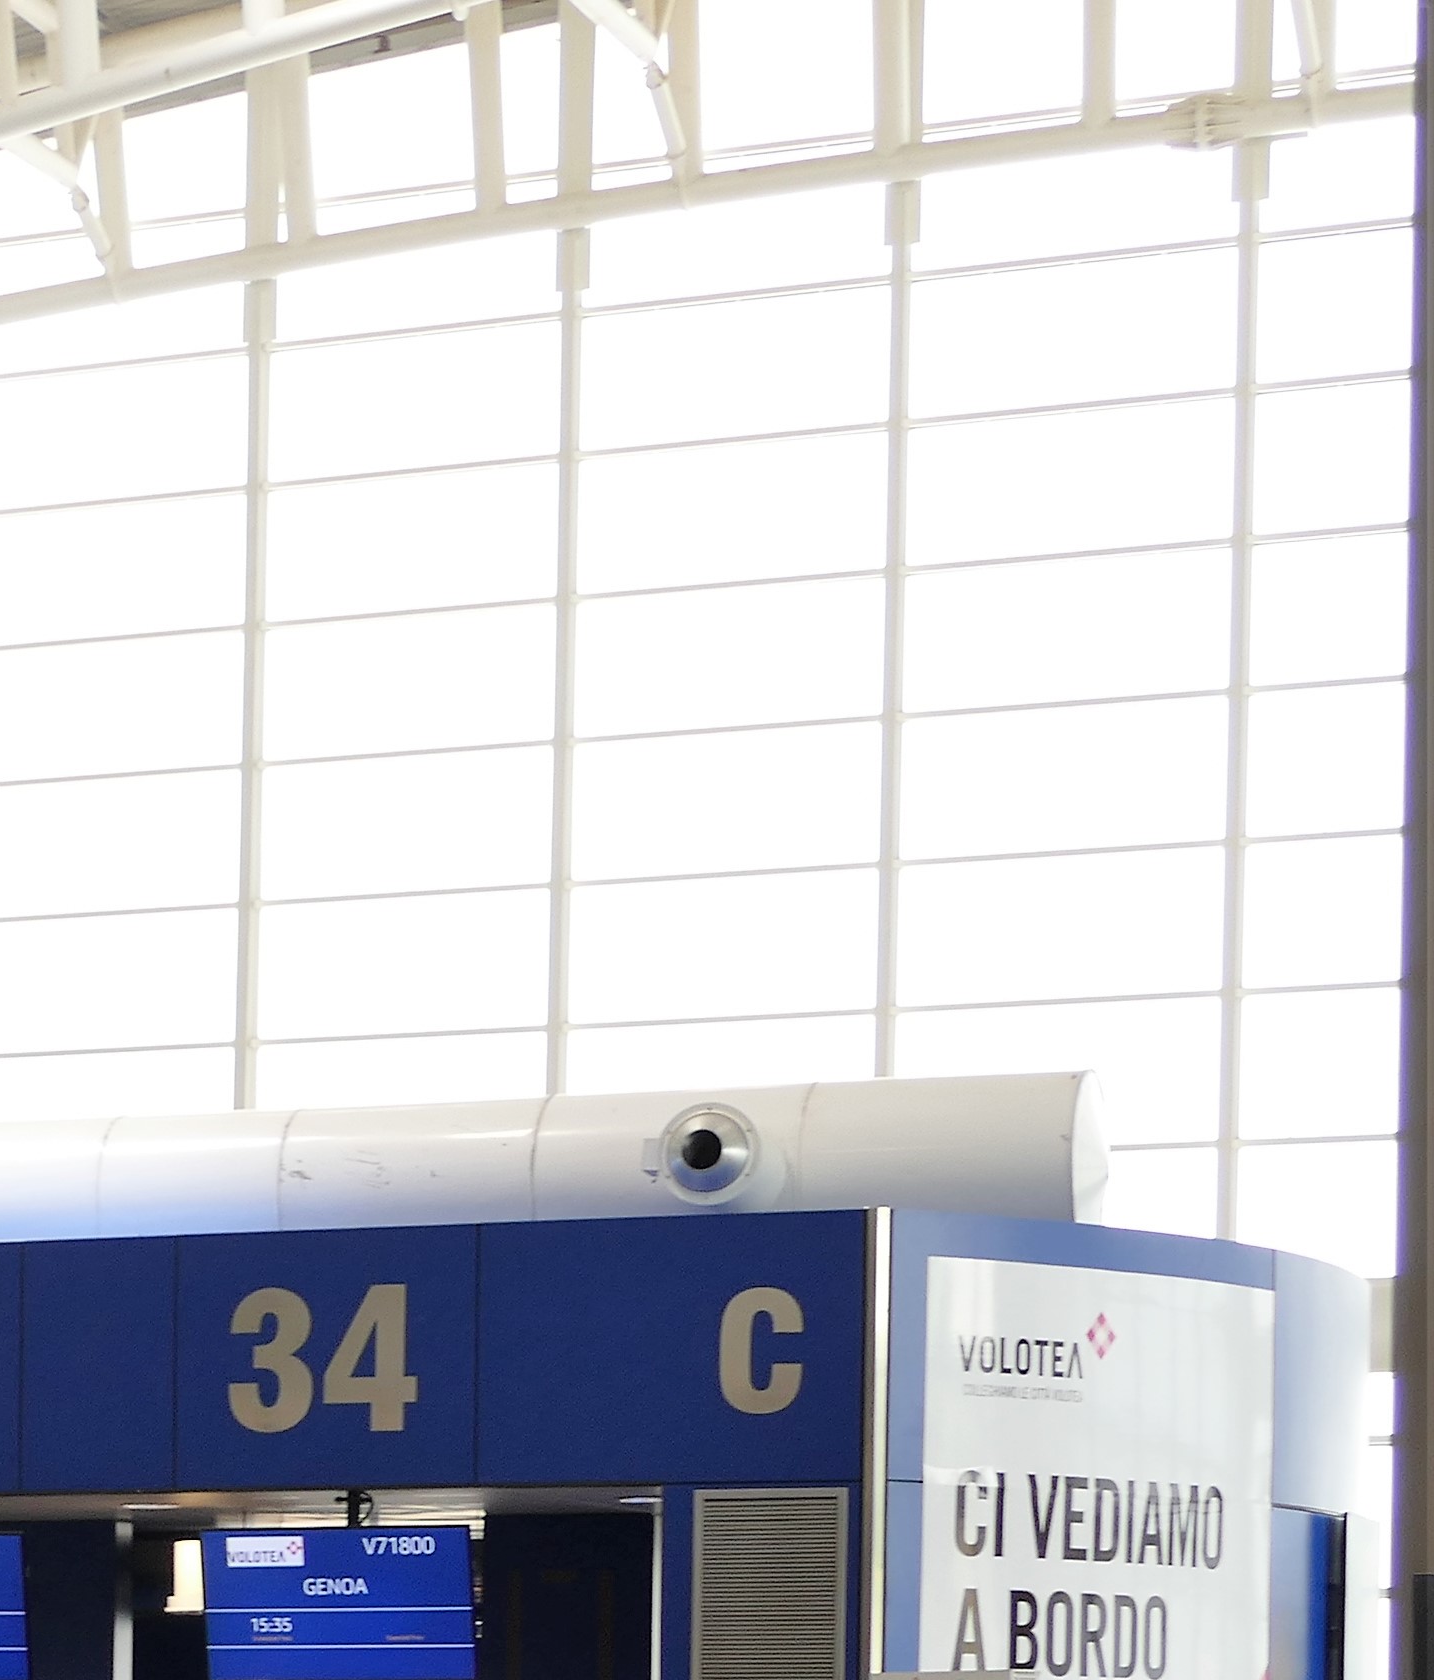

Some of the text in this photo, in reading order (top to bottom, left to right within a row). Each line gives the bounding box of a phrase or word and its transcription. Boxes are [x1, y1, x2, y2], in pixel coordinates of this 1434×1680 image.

[228, 1283, 418, 1433] 34
[719, 1287, 804, 1414] C
[958, 1335, 1084, 1380] VOLOTEA
[956, 1470, 1223, 1570] CI VEDIAMO
[228, 1550, 285, 1563] VOLOTEA
[362, 1536, 435, 1555] V71800
[303, 1577, 369, 1595] GENOA
[250, 1617, 293, 1633] 15:35
[952, 1588, 1167, 1680] A BORDO
